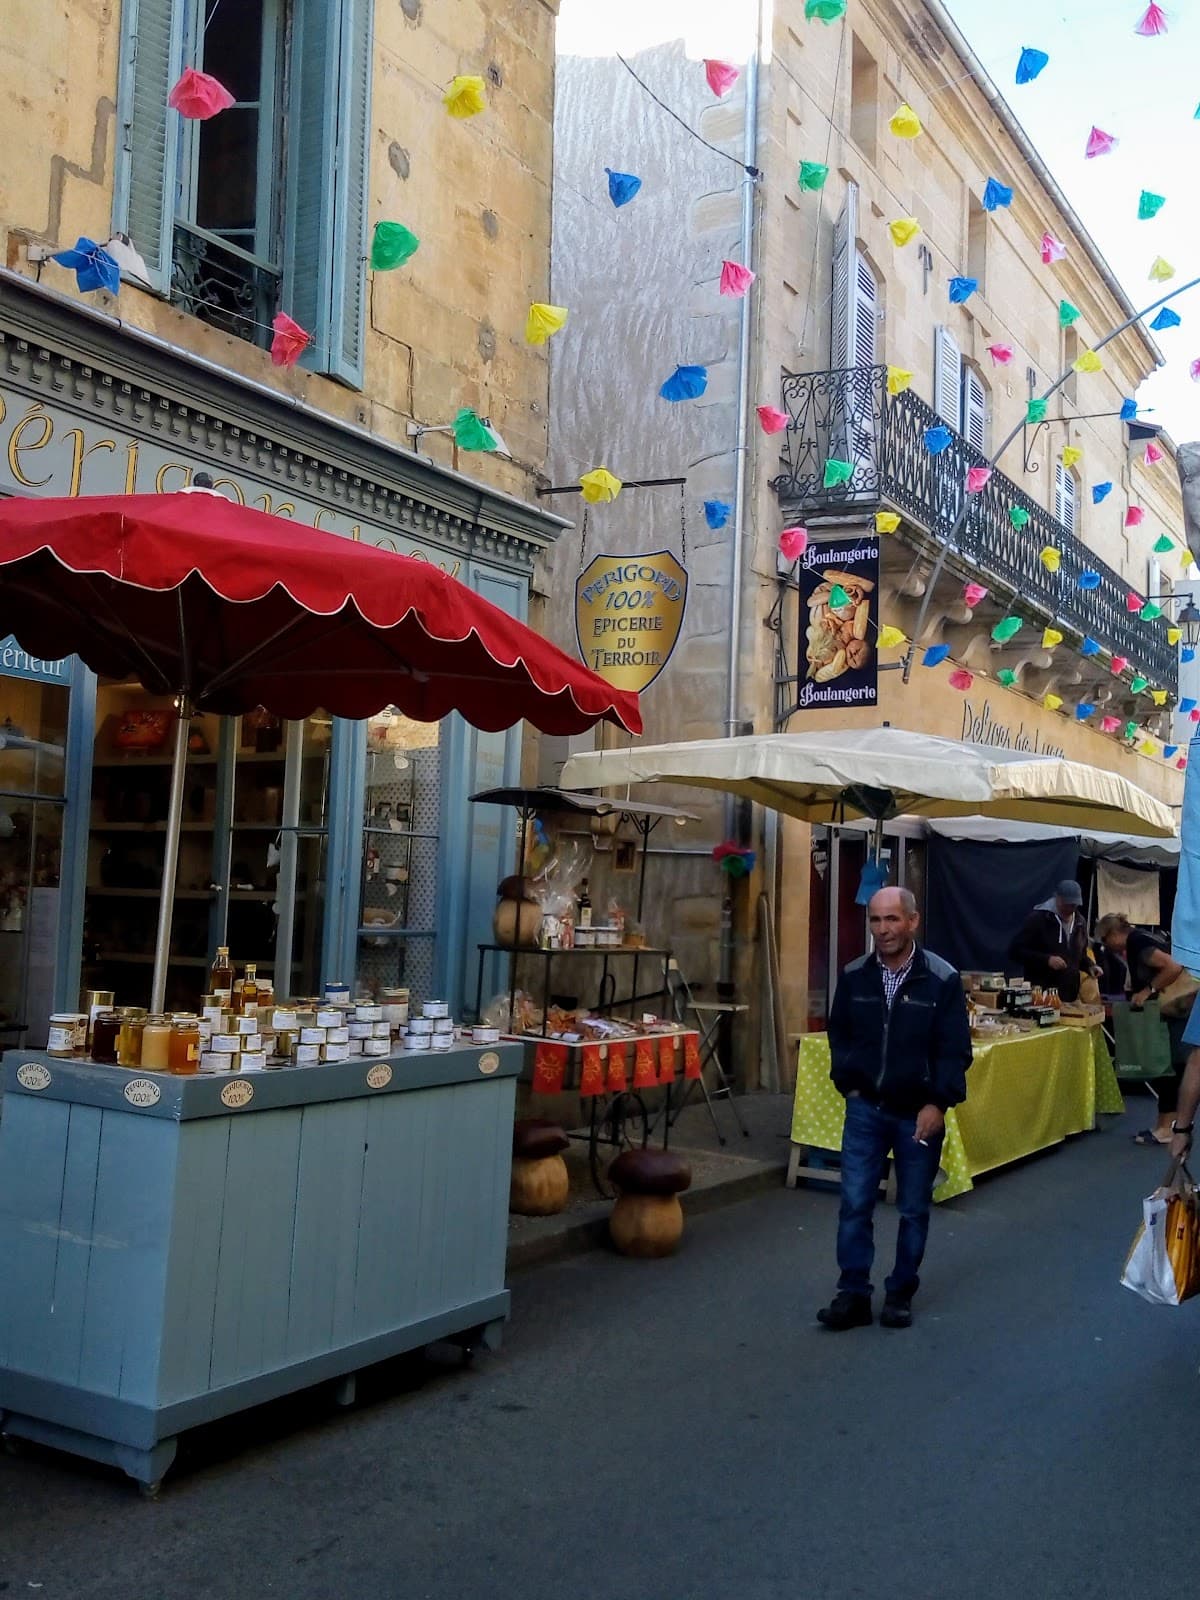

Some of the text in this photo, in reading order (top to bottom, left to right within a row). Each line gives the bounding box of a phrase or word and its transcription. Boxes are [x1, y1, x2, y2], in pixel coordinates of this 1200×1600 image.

[802, 545, 879, 570] Boulangerie
[582, 564, 681, 604] PERIGORD
[606, 590, 656, 610] 100%
[592, 616, 664, 637] EPICERIE
[617, 637, 636, 649] DU
[0, 641, 65, 677] érieur
[591, 648, 662, 671] TERROIR
[799, 682, 877, 707] Boulangerie
